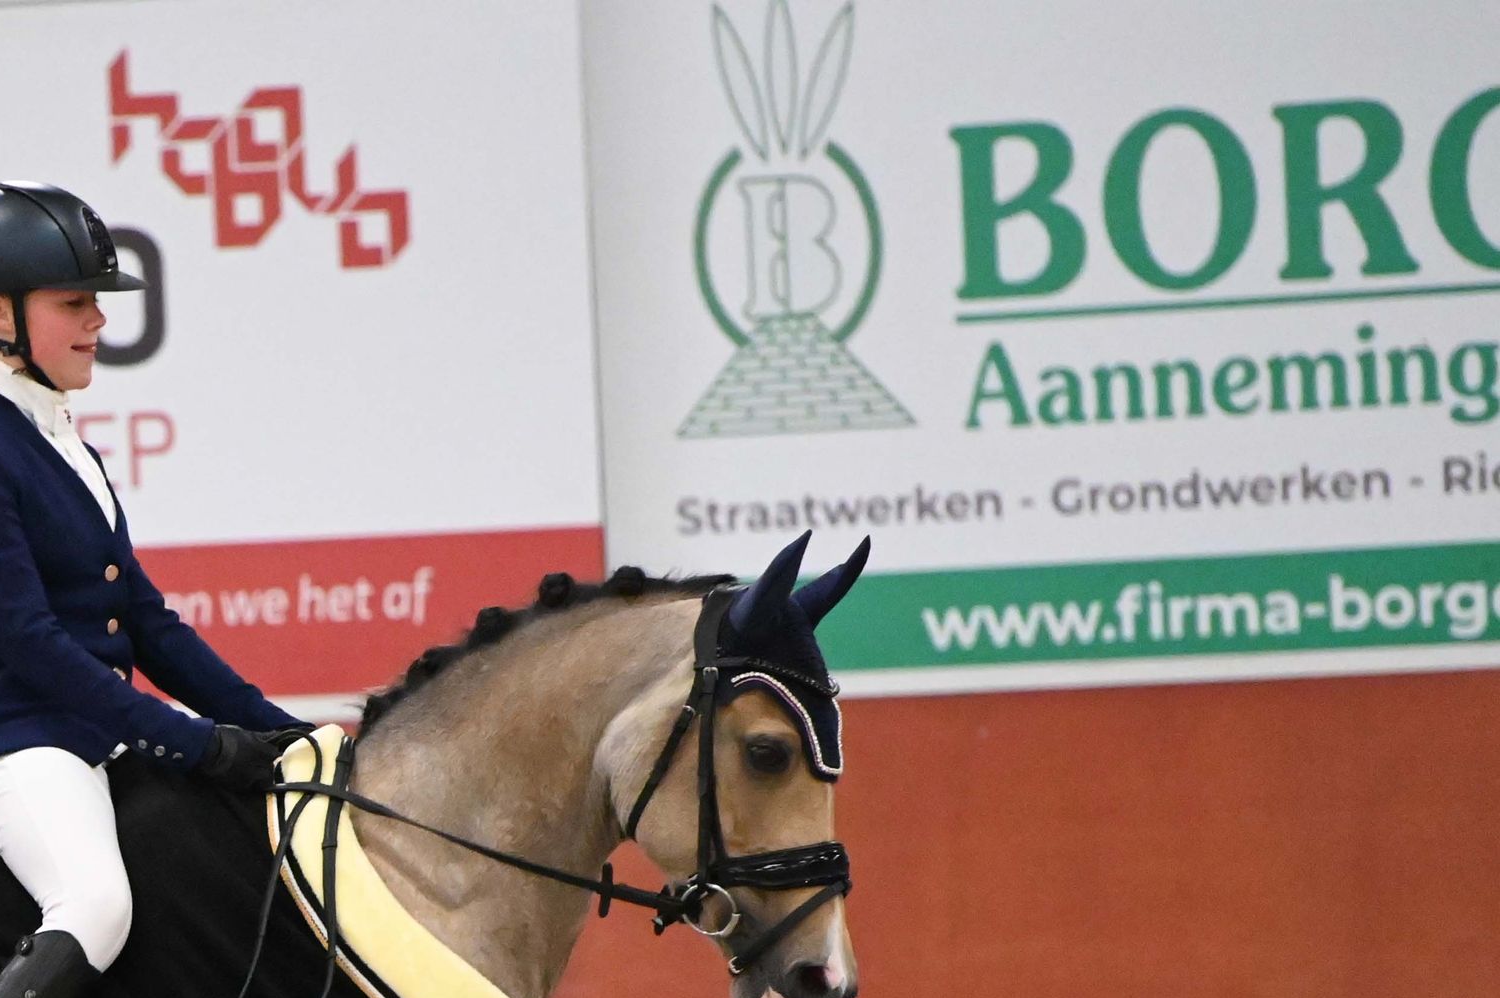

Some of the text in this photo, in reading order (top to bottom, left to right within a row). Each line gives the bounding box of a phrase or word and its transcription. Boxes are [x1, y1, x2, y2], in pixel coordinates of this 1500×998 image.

[676, 483, 1003, 536] Straatwerken
[1051, 463, 1392, 516] Grondwerken
[219, 586, 290, 626] we
[297, 572, 374, 624] het
[381, 566, 433, 625] af
[923, 573, 1500, 651] www.firma-borg
